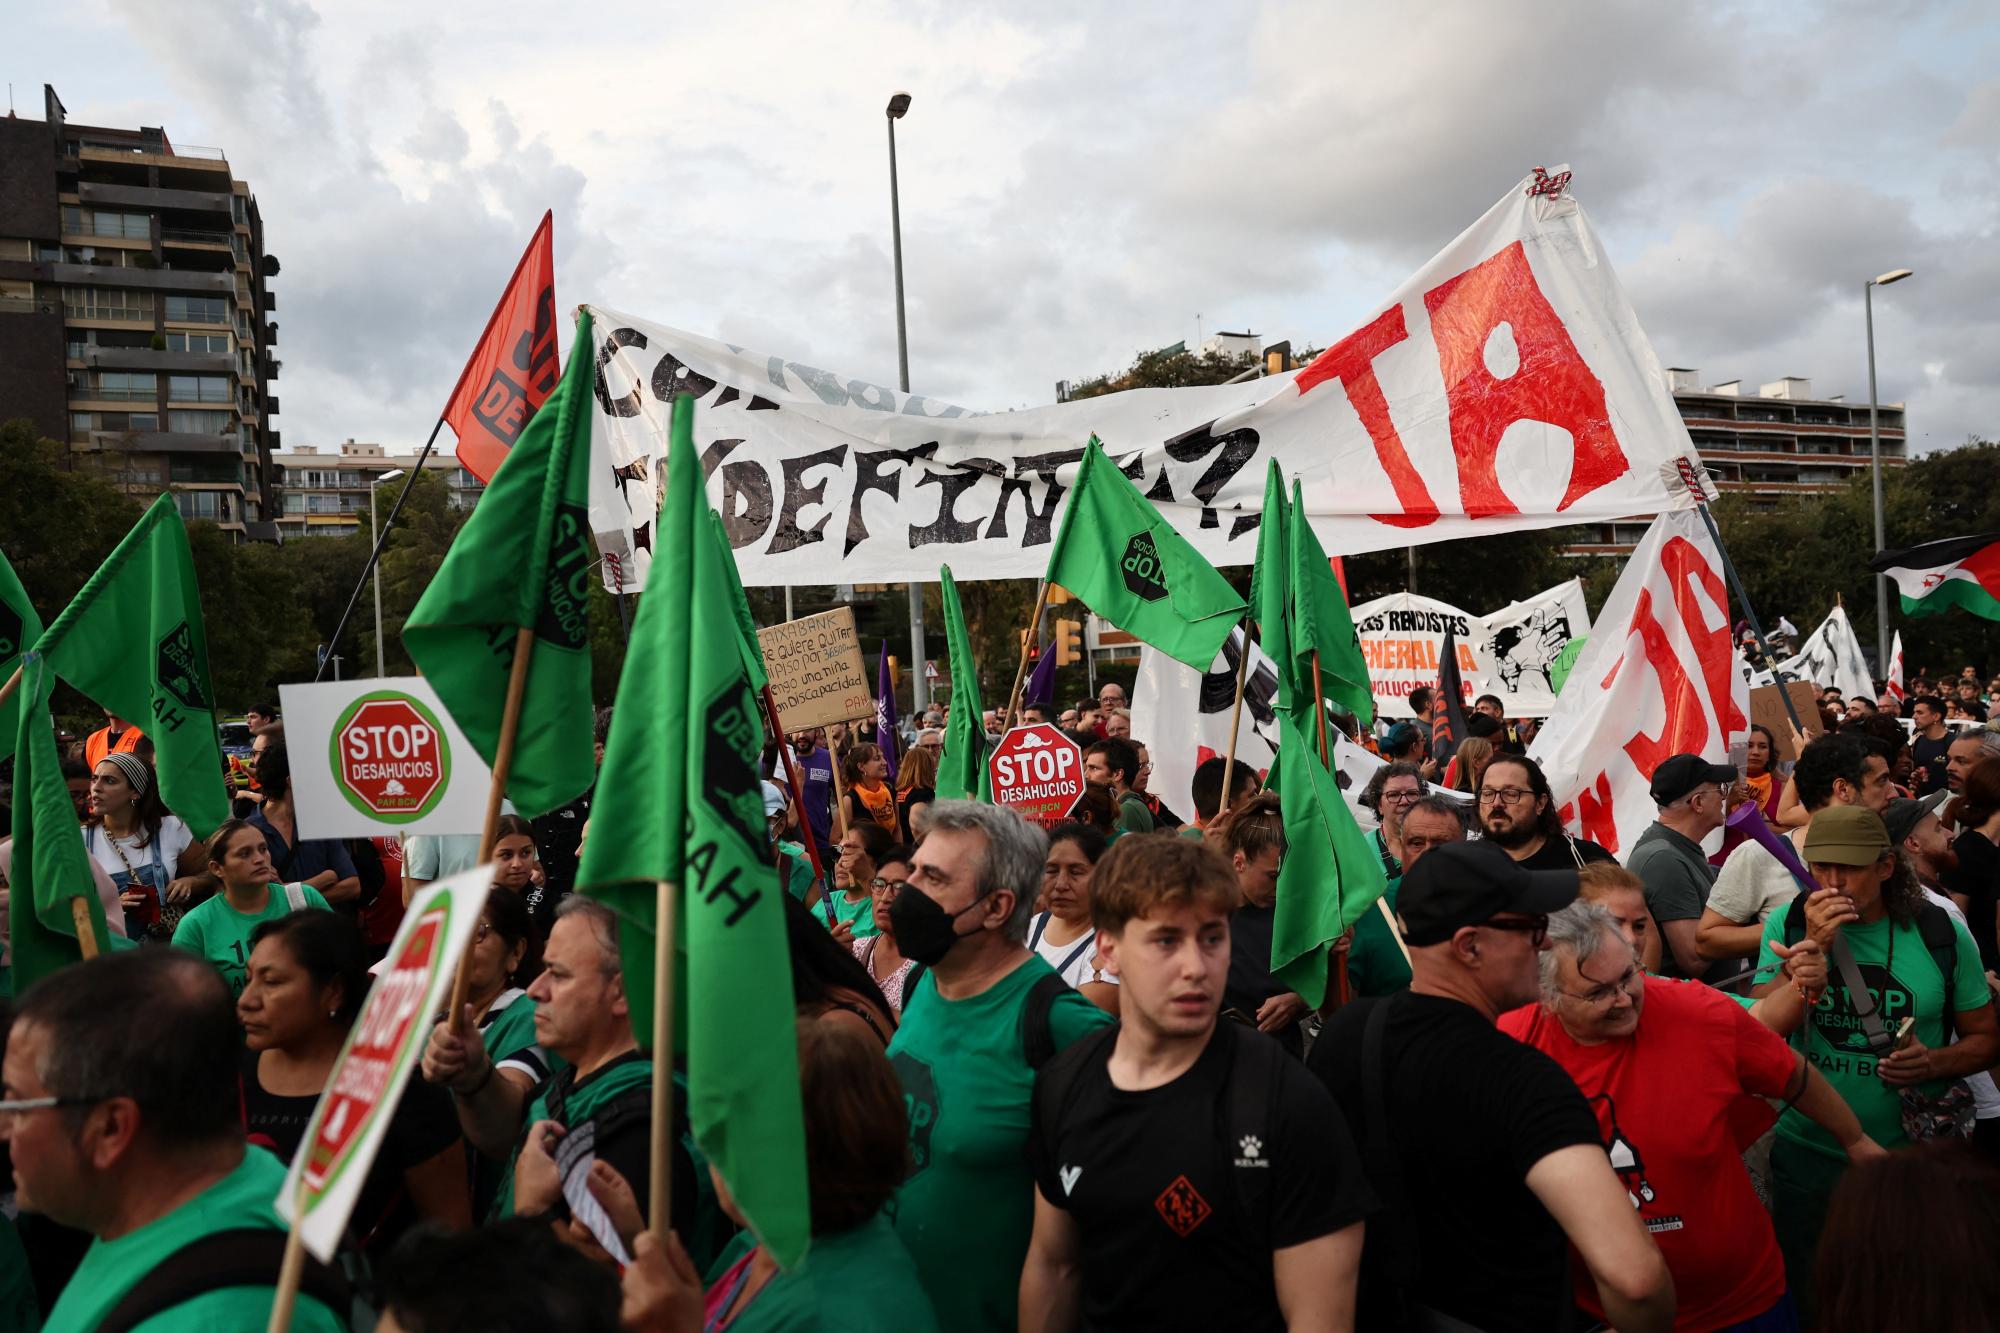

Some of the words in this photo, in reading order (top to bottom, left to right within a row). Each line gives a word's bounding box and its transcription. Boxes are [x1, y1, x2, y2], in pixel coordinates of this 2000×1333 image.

[759, 615, 837, 648] AIXABANK
[1361, 639, 1439, 670] ENERAL
[768, 678, 797, 696] engo
[801, 670, 823, 685] una
[844, 693, 869, 715] PAH
[348, 724, 430, 760] STOP
[352, 761, 433, 780] DESAHUCIOS
[997, 747, 1074, 787] STOP
[377, 798, 396, 806] PAH
[1000, 780, 1077, 803] DESAHUCIOS
[1041, 802, 1060, 812] BCN
